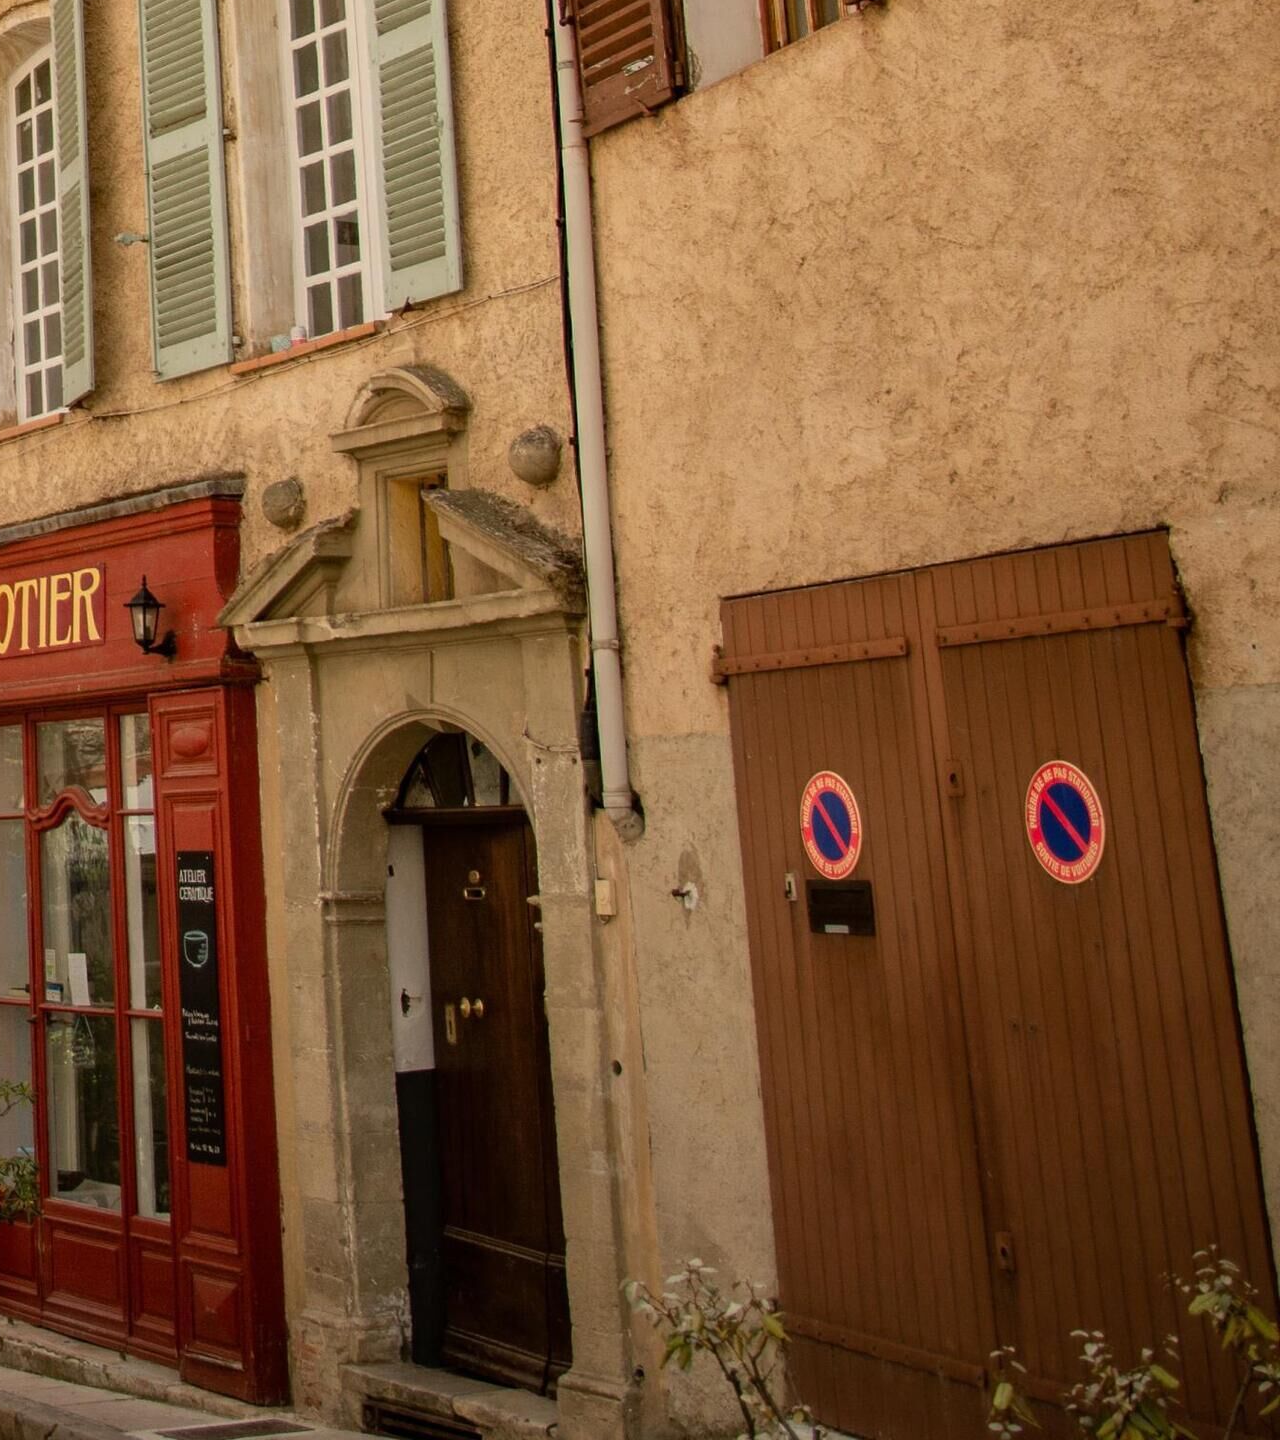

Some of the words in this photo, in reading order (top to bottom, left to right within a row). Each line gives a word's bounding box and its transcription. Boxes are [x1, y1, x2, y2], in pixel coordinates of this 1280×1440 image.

[1034, 777, 1045, 791] DE
[1042, 769, 1054, 783] NE
[1053, 767, 1068, 779] PAS
[1068, 770, 1100, 827] STATIONNER
[179, 868, 206, 883] ATELIER
[1036, 841, 1060, 874] SORTIE
[1060, 864, 1072, 877] DE
[1071, 840, 1098, 877] VOITURES
